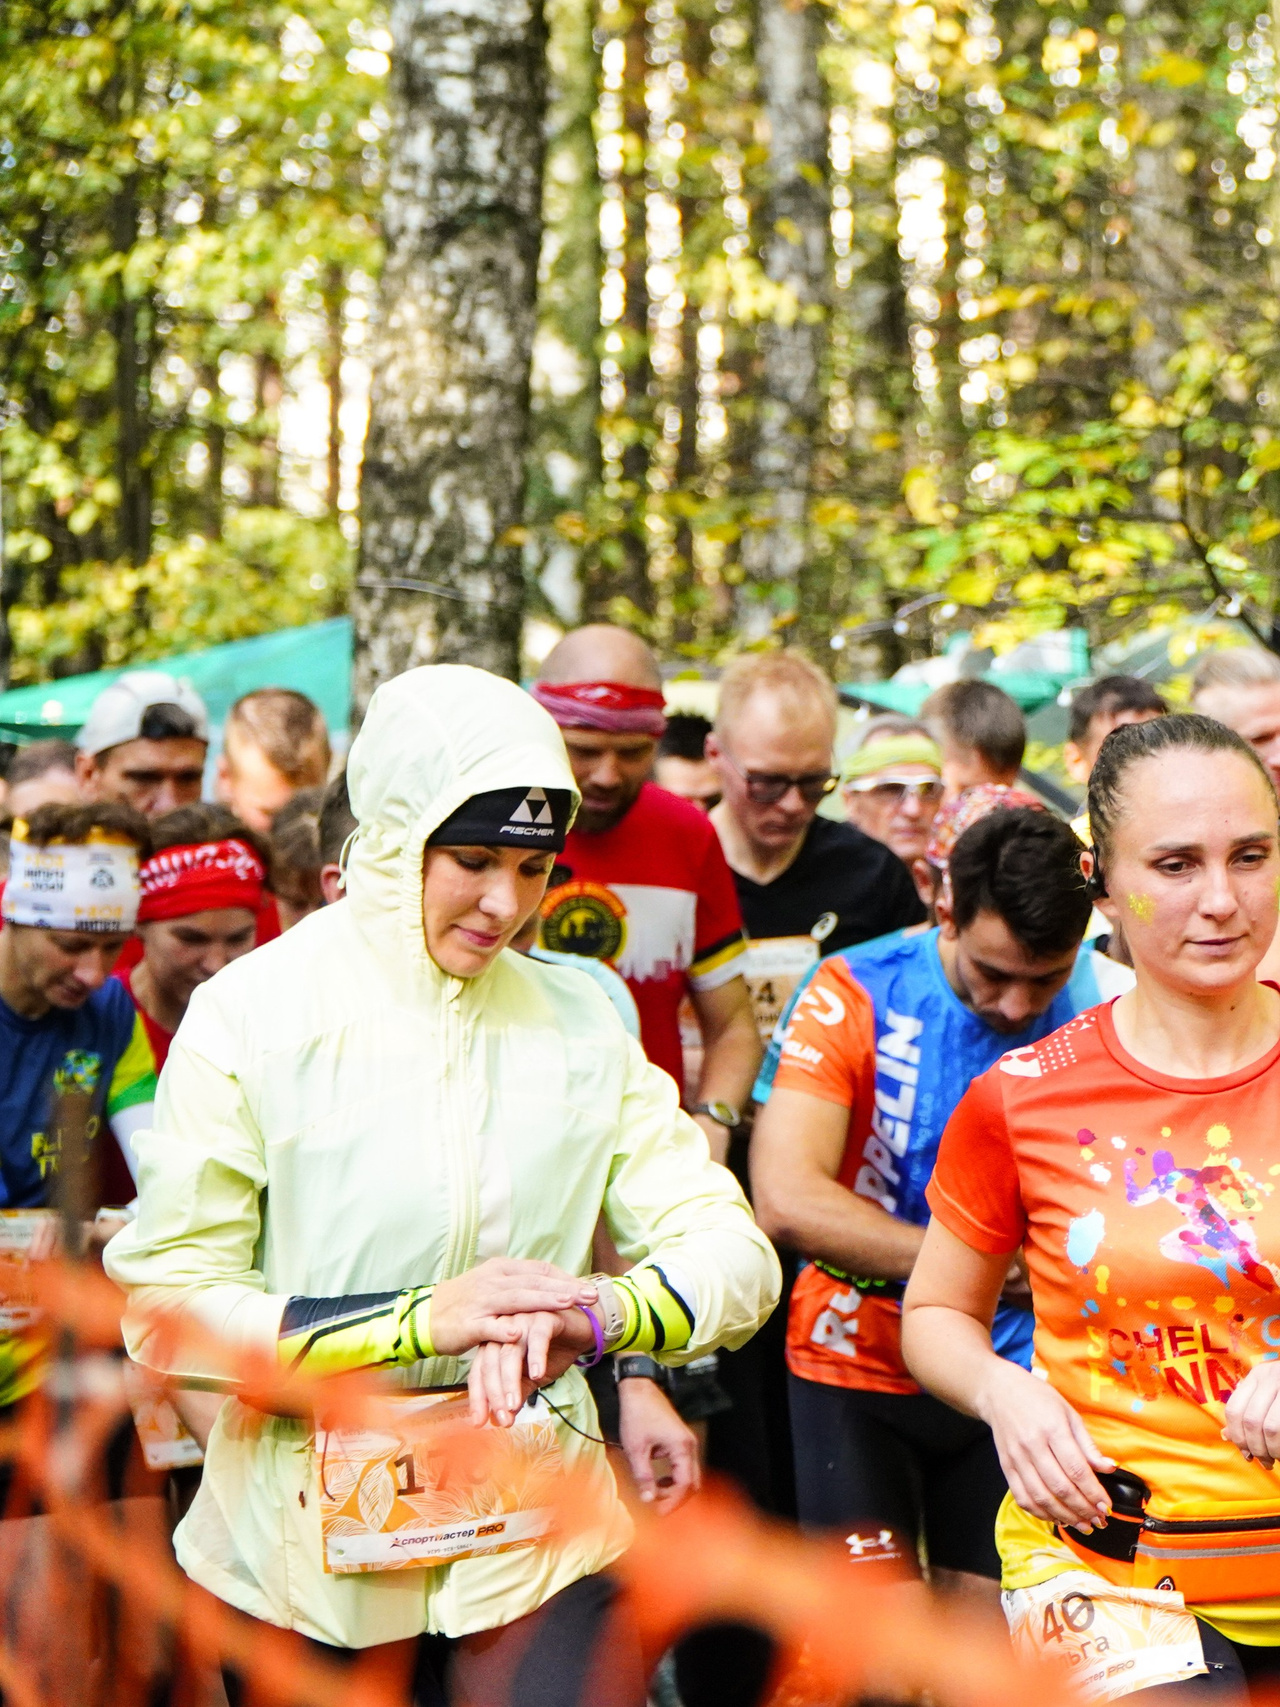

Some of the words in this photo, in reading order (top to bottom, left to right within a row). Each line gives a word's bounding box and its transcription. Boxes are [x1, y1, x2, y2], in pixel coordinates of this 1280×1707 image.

[500, 825, 555, 837] FISCHER
[853, 1007, 924, 1214] PPELIN
[477, 1523, 505, 1536] PRO
[1042, 1591, 1095, 1644] 40
[1107, 1659, 1136, 1677] PRO
